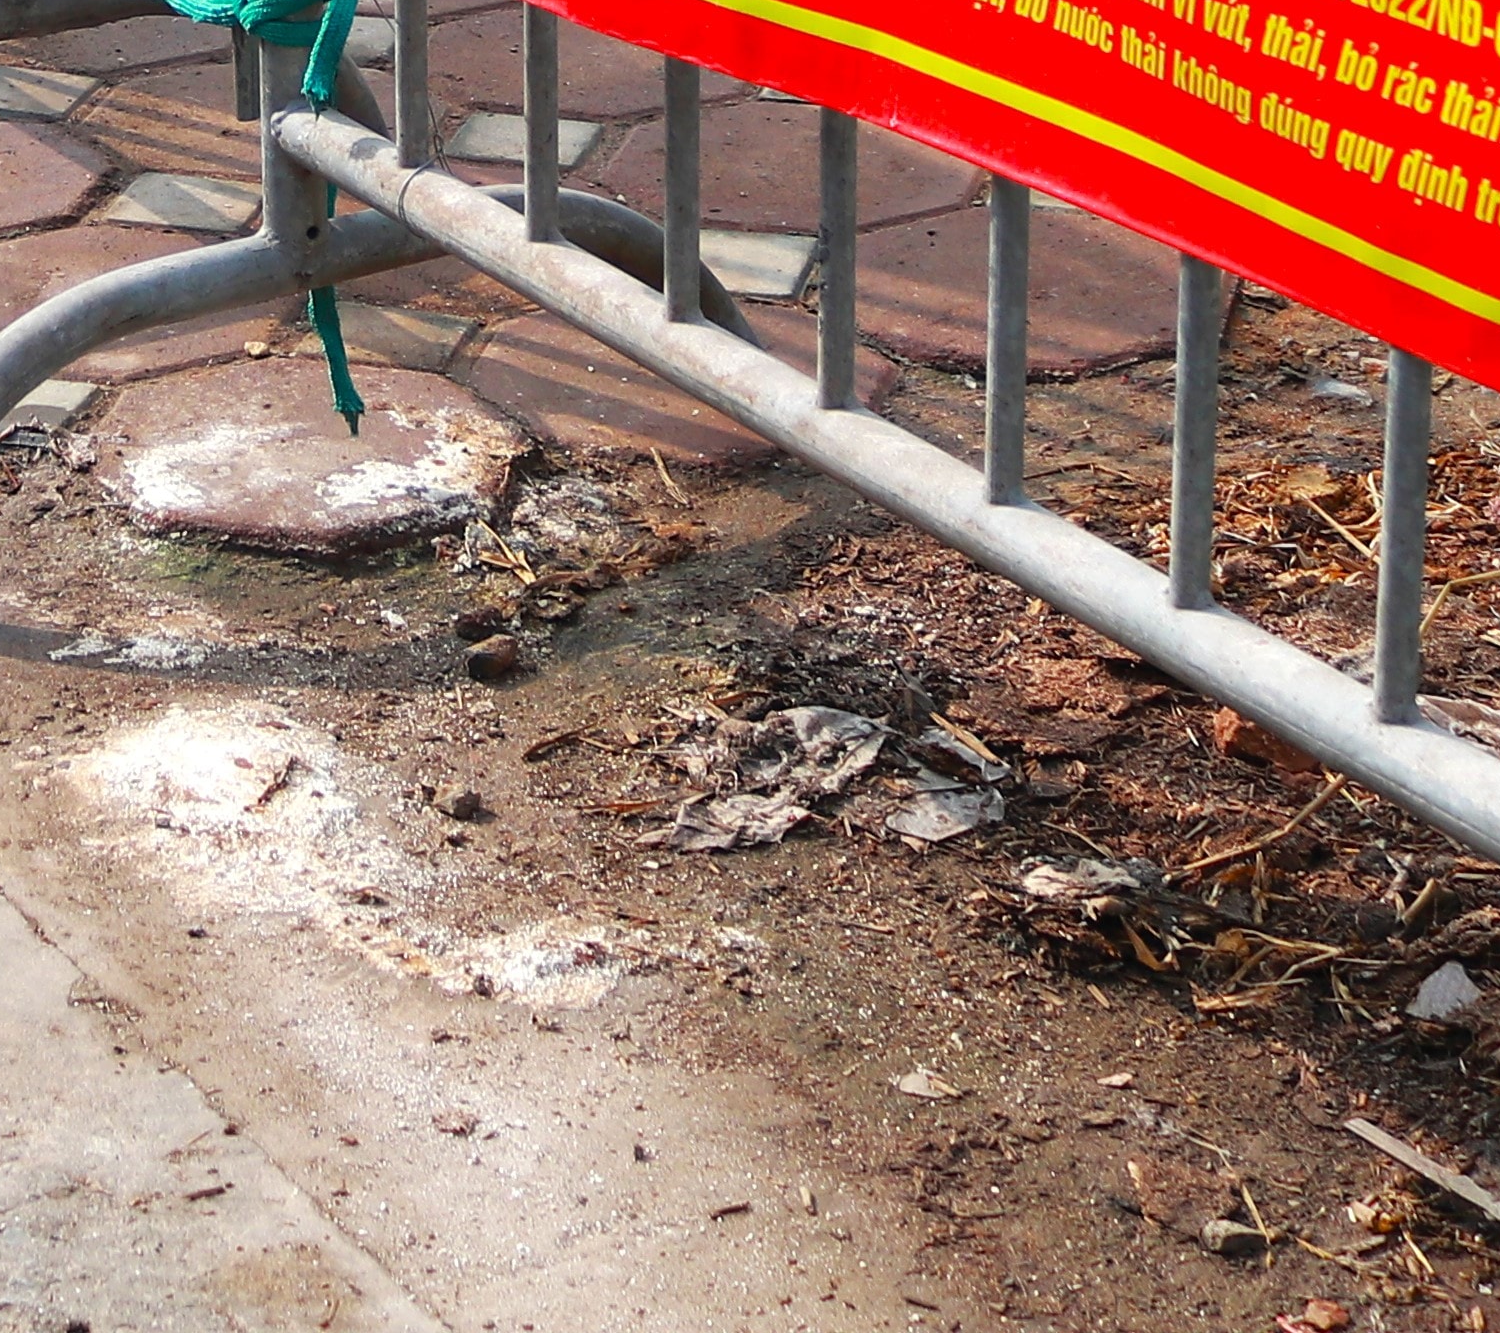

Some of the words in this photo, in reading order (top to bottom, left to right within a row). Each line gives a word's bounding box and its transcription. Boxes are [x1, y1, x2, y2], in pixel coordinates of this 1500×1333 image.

[1119, 22, 1166, 80] thải
[1171, 47, 1252, 125] không
[1258, 90, 1331, 160] đúng
[1334, 126, 1394, 184] quy
[1396, 146, 1469, 212] định
